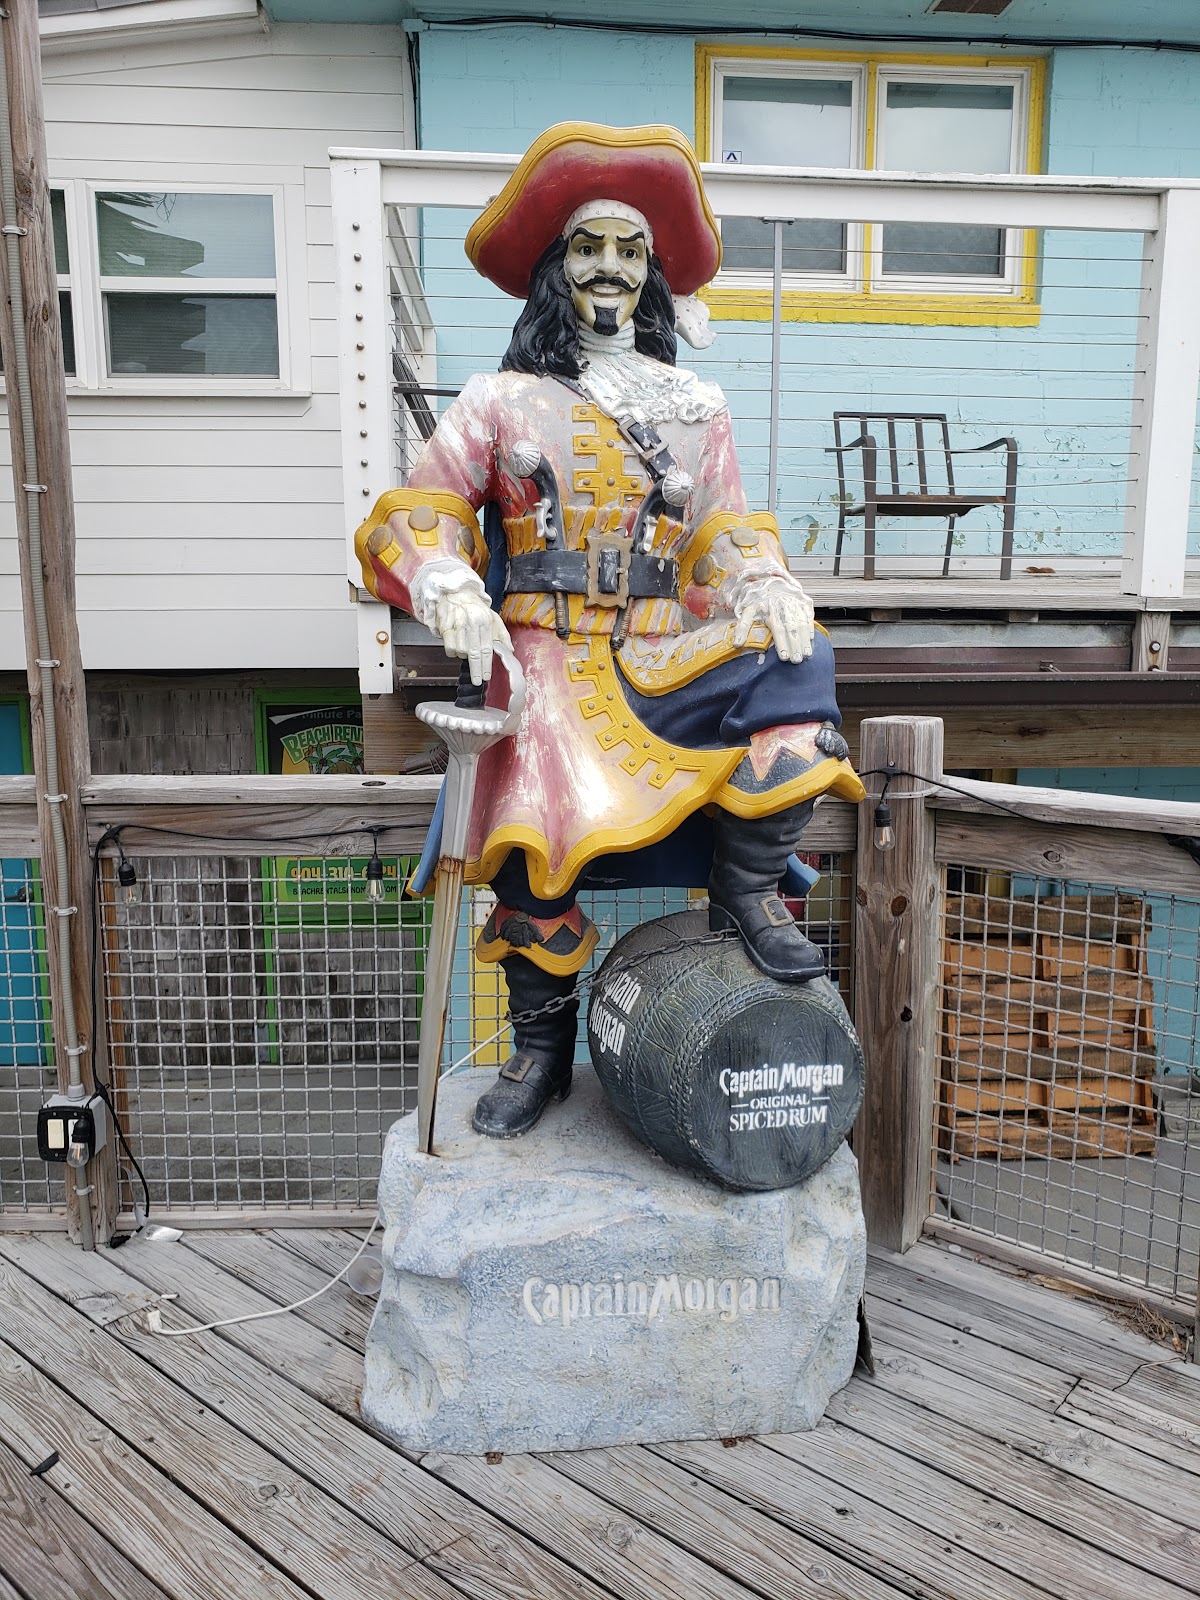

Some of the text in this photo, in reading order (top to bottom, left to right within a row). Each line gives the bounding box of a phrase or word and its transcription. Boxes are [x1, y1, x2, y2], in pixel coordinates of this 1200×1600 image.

[281, 725, 331, 764] BEACH
[589, 994, 625, 1056] Morgan
[719, 1063, 843, 1098] Captain Morgan
[729, 1105, 827, 1132] SPICED RUM
[750, 1094, 810, 1109] ORIGINAL
[522, 1271, 781, 1328] Captain Morgan
